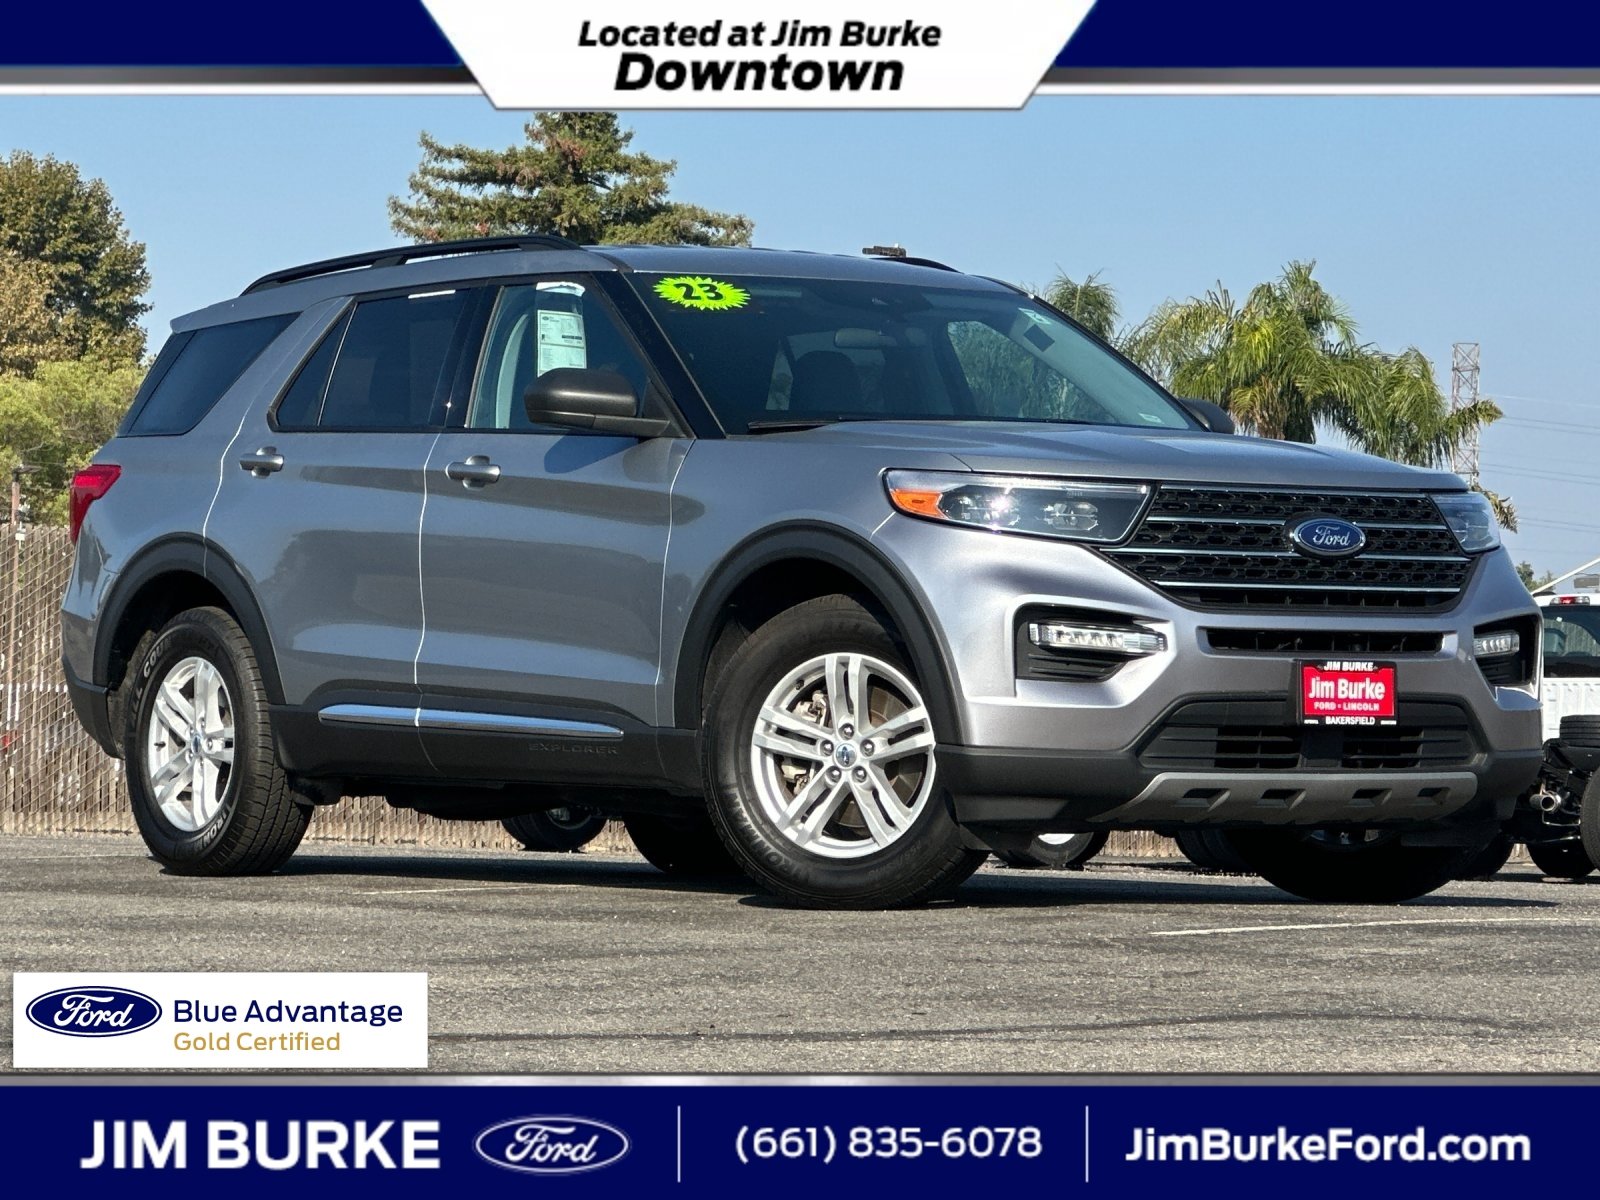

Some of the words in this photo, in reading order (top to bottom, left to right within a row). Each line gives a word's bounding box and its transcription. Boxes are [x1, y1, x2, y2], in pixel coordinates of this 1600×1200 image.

[673, 283, 723, 301] 23
[1313, 525, 1351, 547] Ford
[1323, 661, 1341, 671] JIM
[1342, 661, 1374, 672] BURKE
[1308, 676, 1335, 699] Jim
[1337, 677, 1386, 700] Burke
[1313, 701, 1337, 710] FORD
[1342, 702, 1380, 711] LINCOLN
[1325, 716, 1376, 725] BAKERSFIELD
[528, 743, 618, 754] EXPLORER
